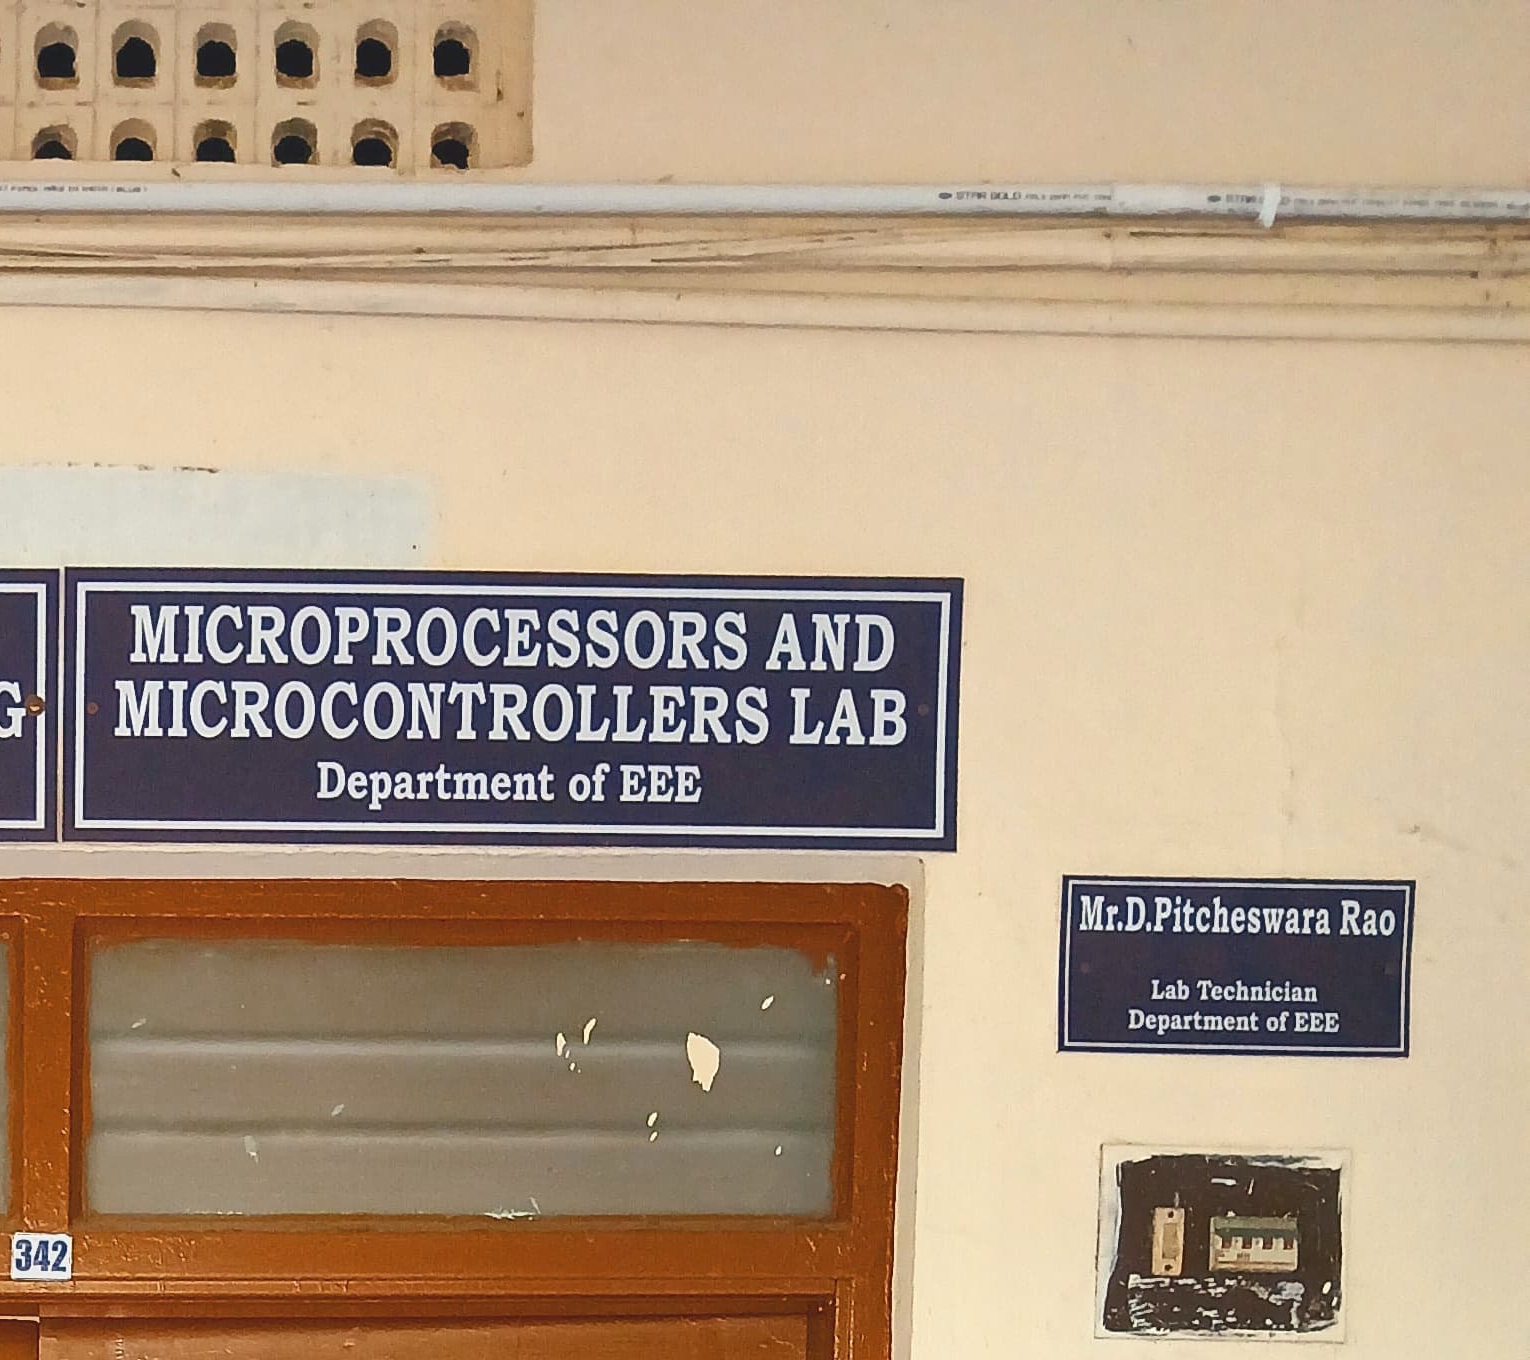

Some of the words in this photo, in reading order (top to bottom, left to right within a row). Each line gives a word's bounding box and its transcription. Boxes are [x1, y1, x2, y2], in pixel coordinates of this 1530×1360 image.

[129, 604, 748, 670] MICROPROCESSORS
[766, 612, 896, 672] AND
[114, 679, 770, 745] MICROCONTROLLERS
[790, 687, 908, 746] LAB
[316, 761, 555, 811] Department
[568, 762, 611, 802] of
[619, 764, 702, 804] EEE
[1079, 895, 1331, 936] Mr.D.Pitcheswara
[1339, 899, 1396, 936] Rao
[1151, 980, 1190, 1000] Lab
[1196, 979, 1318, 1002] Technician
[1128, 1009, 1259, 1035] Department
[1266, 1011, 1290, 1032] of
[1294, 1012, 1340, 1033] EEE
[15, 1239, 68, 1272] 342
